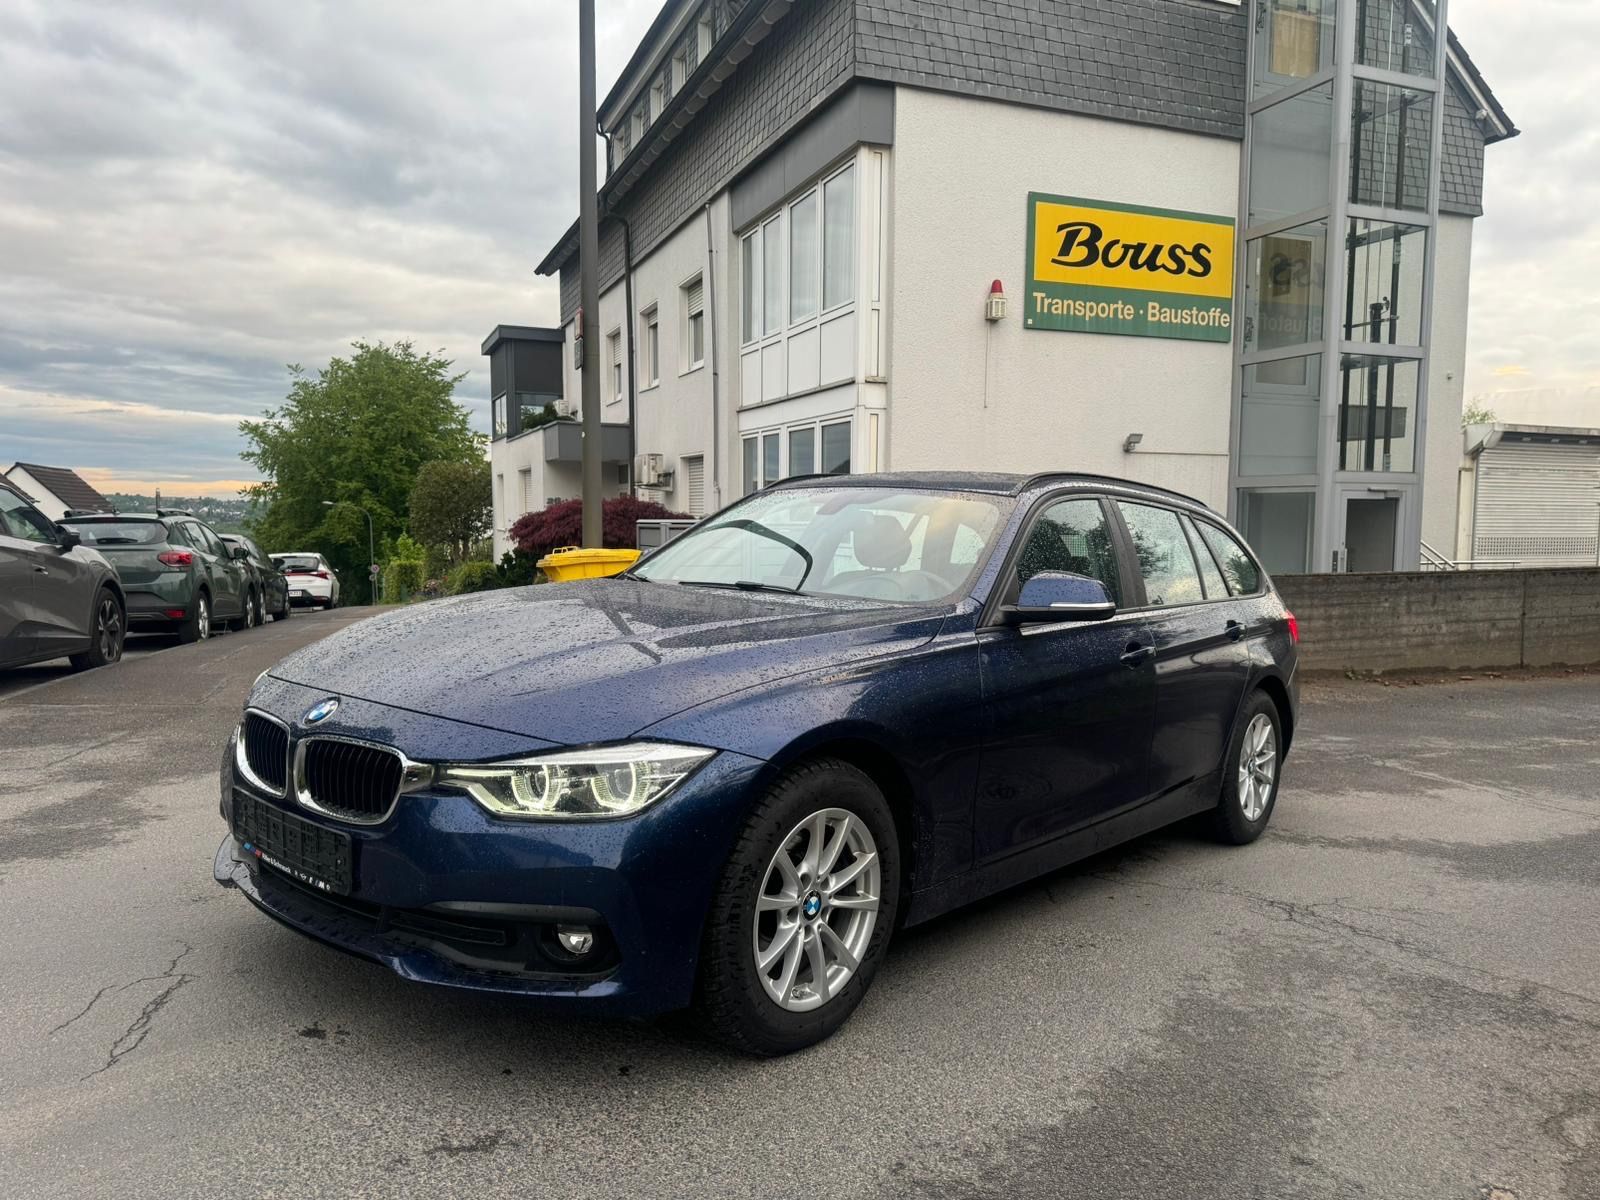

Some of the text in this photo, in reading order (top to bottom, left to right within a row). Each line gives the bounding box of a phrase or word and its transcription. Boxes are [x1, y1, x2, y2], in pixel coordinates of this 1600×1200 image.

[1051, 221, 1212, 277] Bouss
[1033, 292, 1230, 327] Transporte Baustoffe
